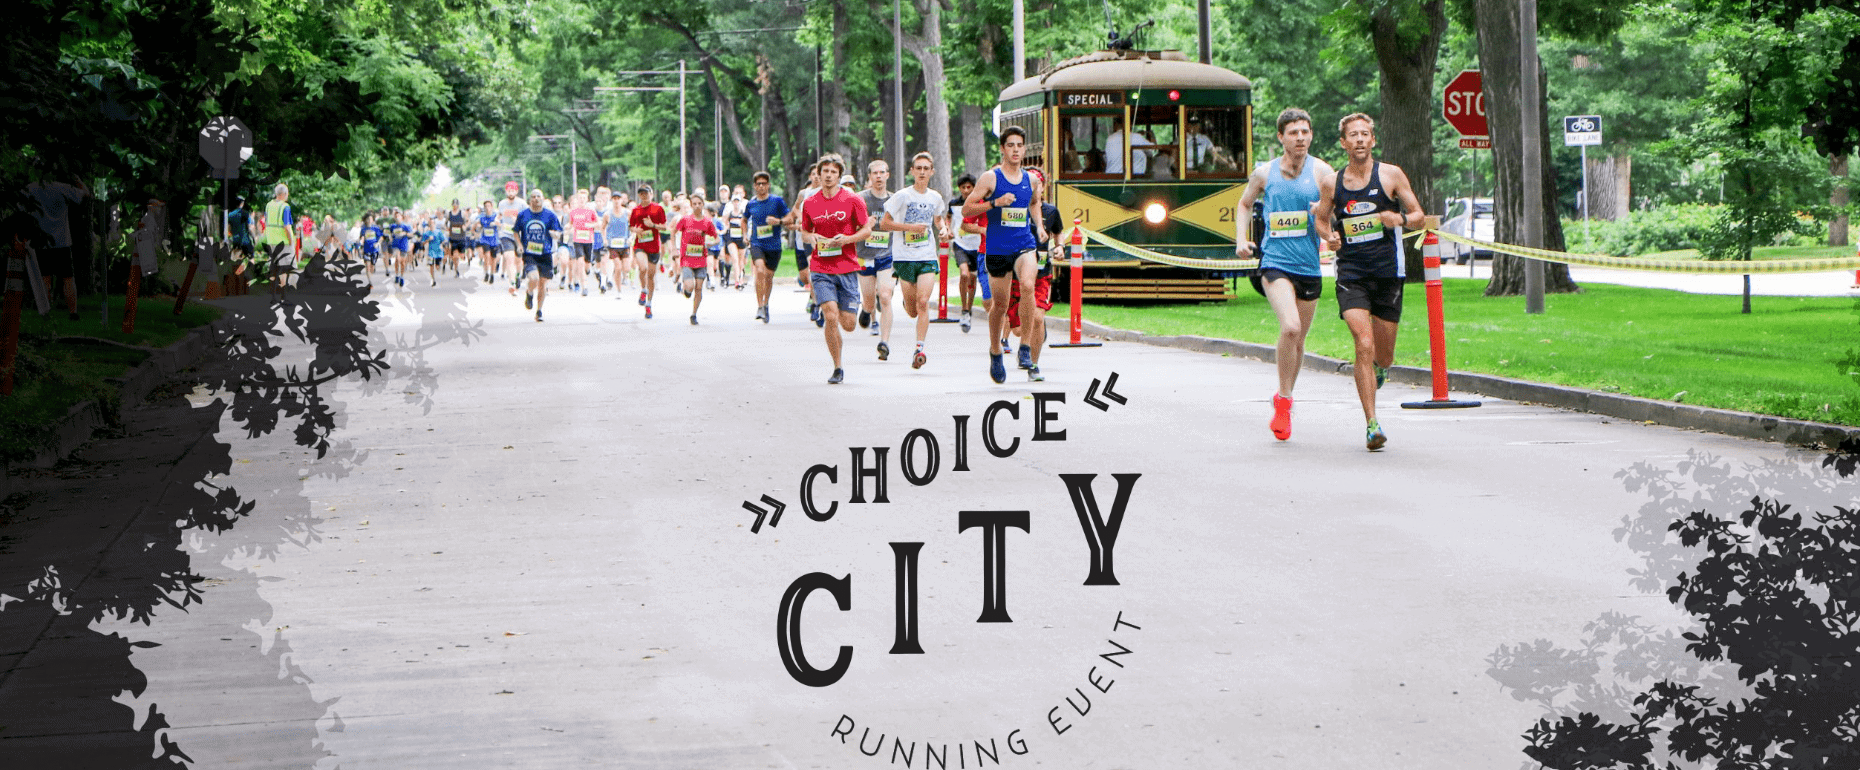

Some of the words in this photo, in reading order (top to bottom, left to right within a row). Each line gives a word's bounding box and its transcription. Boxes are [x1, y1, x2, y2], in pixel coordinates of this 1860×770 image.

[1068, 94, 1113, 105] SPECIAL
[1447, 91, 1485, 116] STO
[1583, 133, 1599, 142] LANE
[1461, 140, 1474, 148] ALL
[1476, 140, 1491, 148] WAY
[1007, 212, 1024, 220] 580
[1073, 208, 1090, 223] 21
[1219, 207, 1235, 222] 21
[1277, 218, 1299, 227] 440
[1351, 221, 1374, 233] 364
